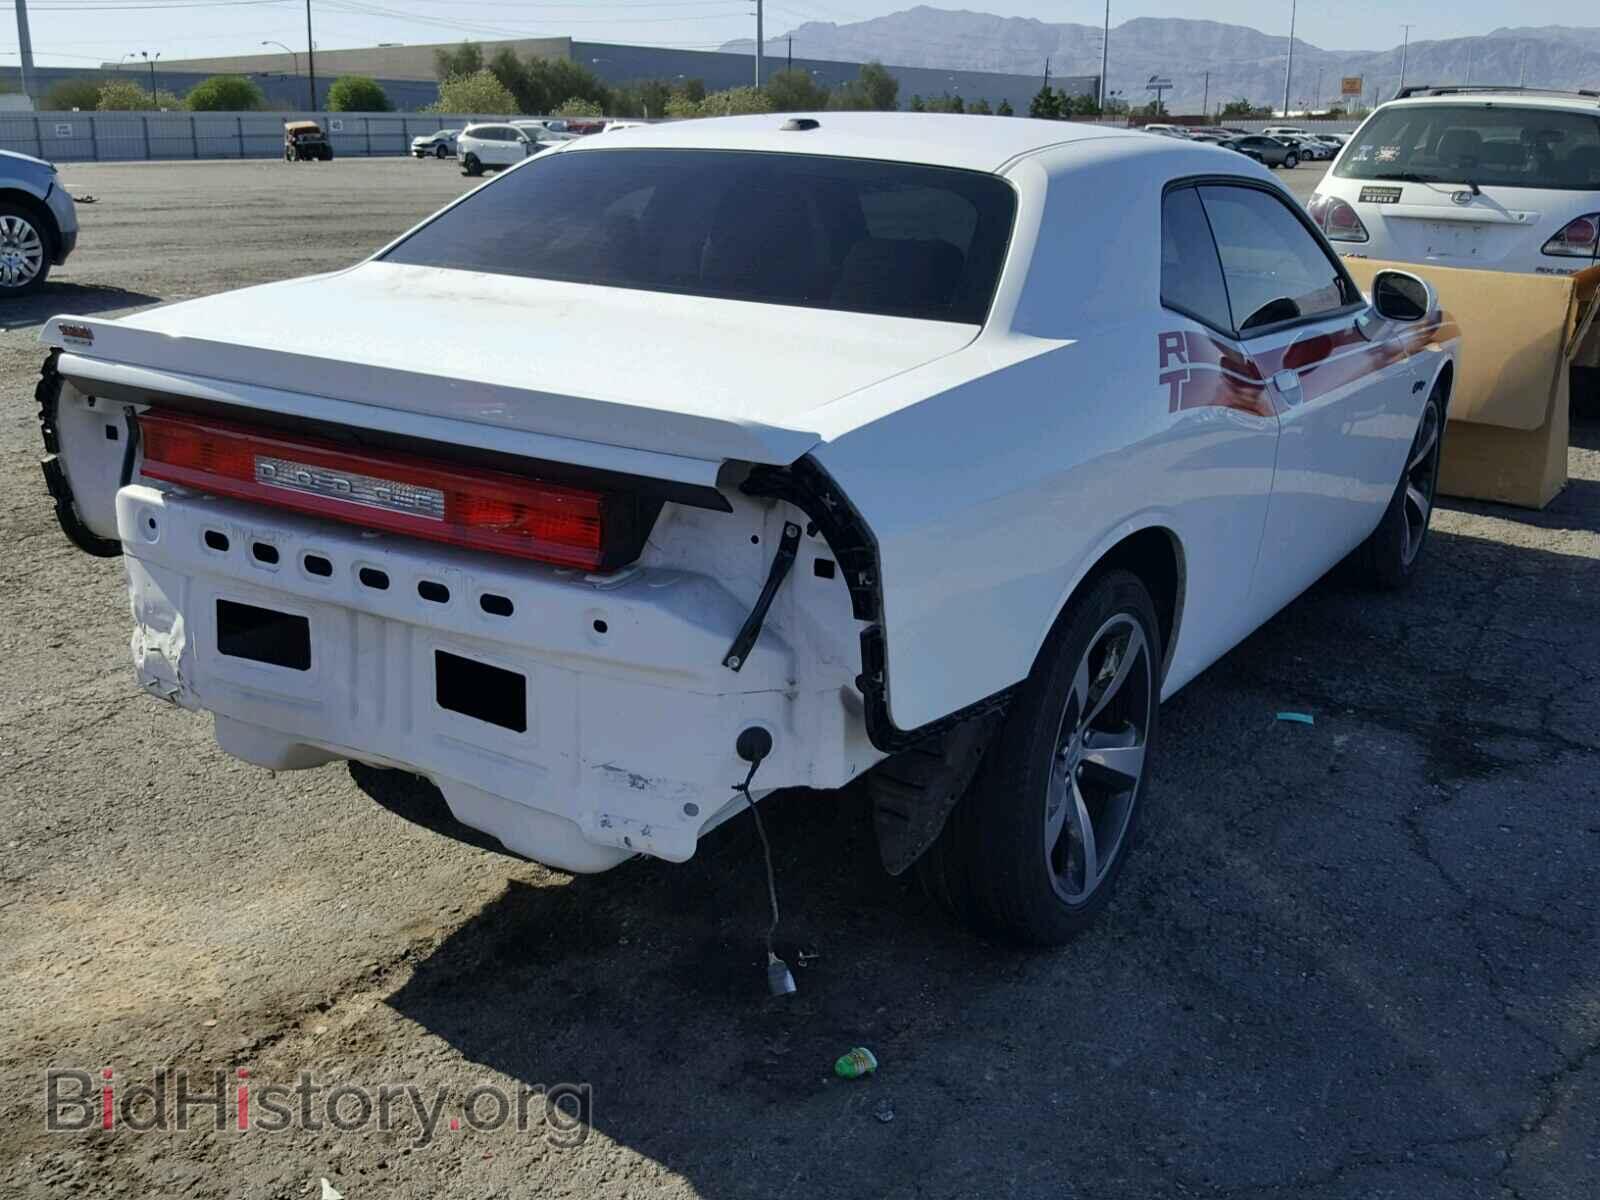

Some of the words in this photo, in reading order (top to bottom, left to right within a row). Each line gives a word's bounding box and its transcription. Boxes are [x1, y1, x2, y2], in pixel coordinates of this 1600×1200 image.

[1158, 330, 1187, 368] R
[1159, 369, 1188, 414] T
[258, 462, 435, 511] DODGE
